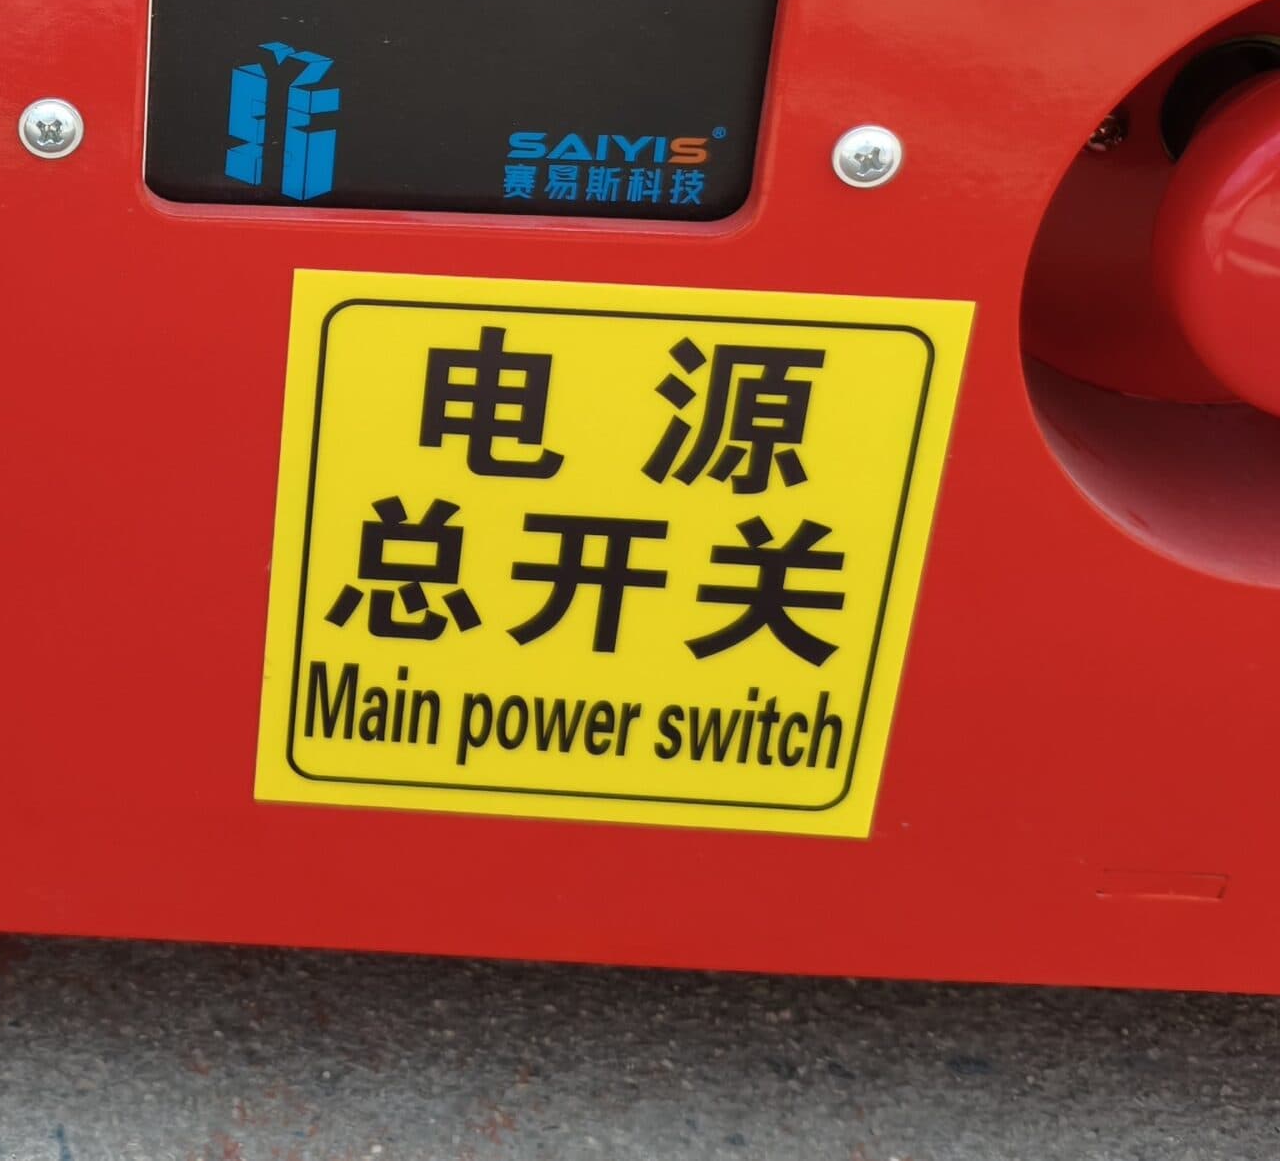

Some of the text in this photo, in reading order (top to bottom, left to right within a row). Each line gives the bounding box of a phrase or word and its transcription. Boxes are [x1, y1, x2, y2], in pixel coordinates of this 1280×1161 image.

[503, 164, 705, 204] 赛易斯科技
[507, 132, 708, 164] SAIYIS
[324, 495, 846, 667] 总开关
[303, 660, 843, 770] Main power switch
